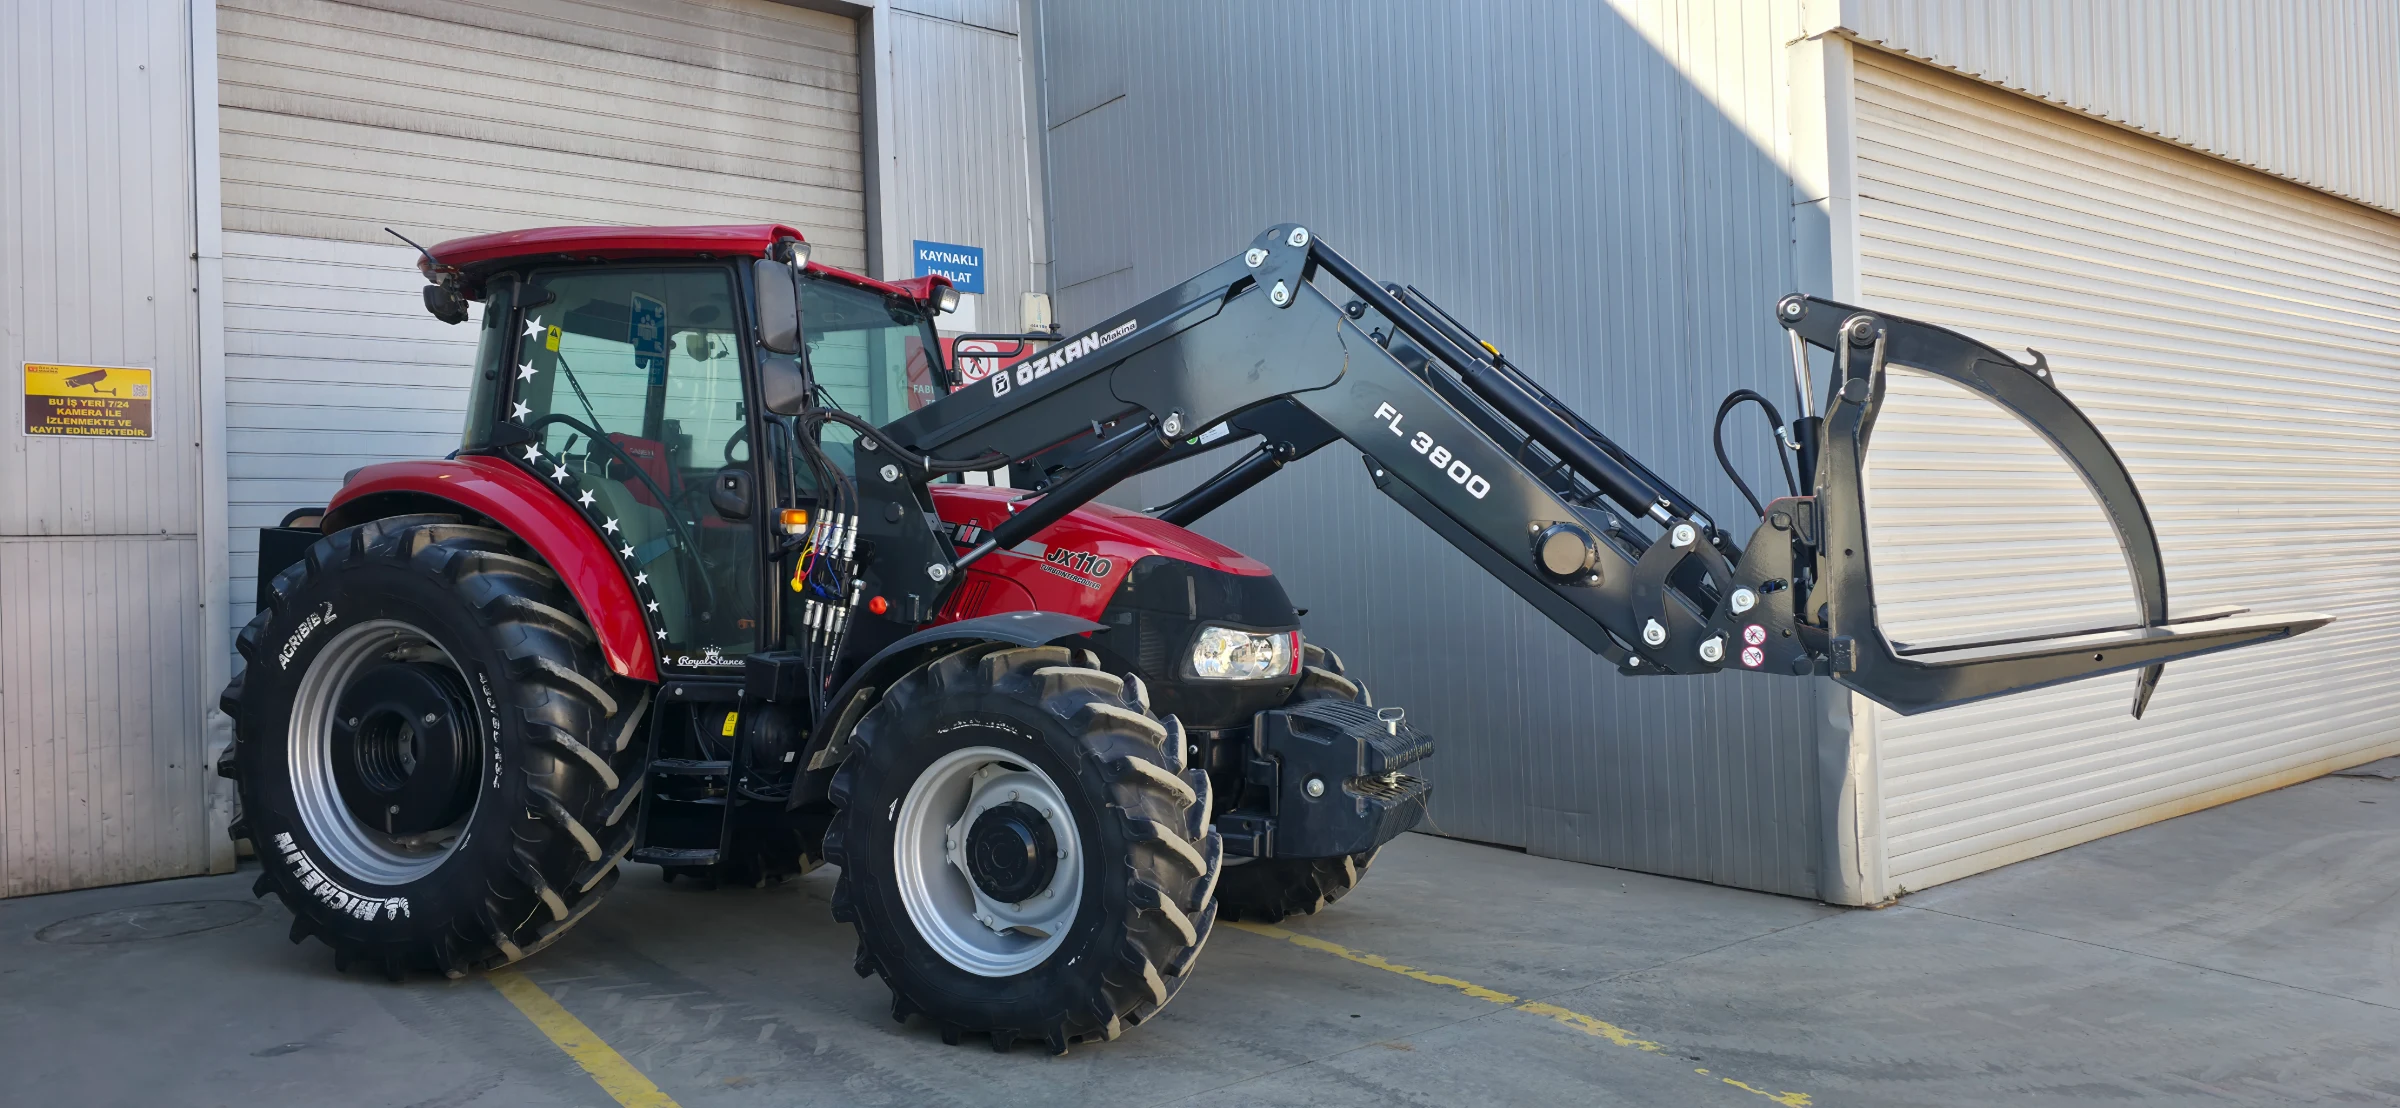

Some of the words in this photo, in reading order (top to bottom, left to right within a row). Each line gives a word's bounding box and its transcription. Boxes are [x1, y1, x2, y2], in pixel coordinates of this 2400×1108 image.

[920, 249, 978, 267] KAYNAKLI
[1016, 332, 1100, 386] ÖZKAN
[1101, 320, 1136, 346] Makina
[48, 398, 63, 406] BU
[67, 397, 77, 407] İŞ
[81, 398, 105, 408] YERİ
[109, 400, 129, 408] 7/24
[57, 408, 102, 417] KAMERA
[105, 409, 121, 417] İLE
[46, 416, 115, 427] İZLENMEKTE
[117, 419, 132, 427] VE
[30, 426, 63, 434] KAYIT
[66, 425, 147, 437] EDİLMEKTEDİR.
[1373, 401, 1403, 437] FL
[1410, 431, 1491, 499] 3800
[274, 831, 382, 922] MICHELIN
